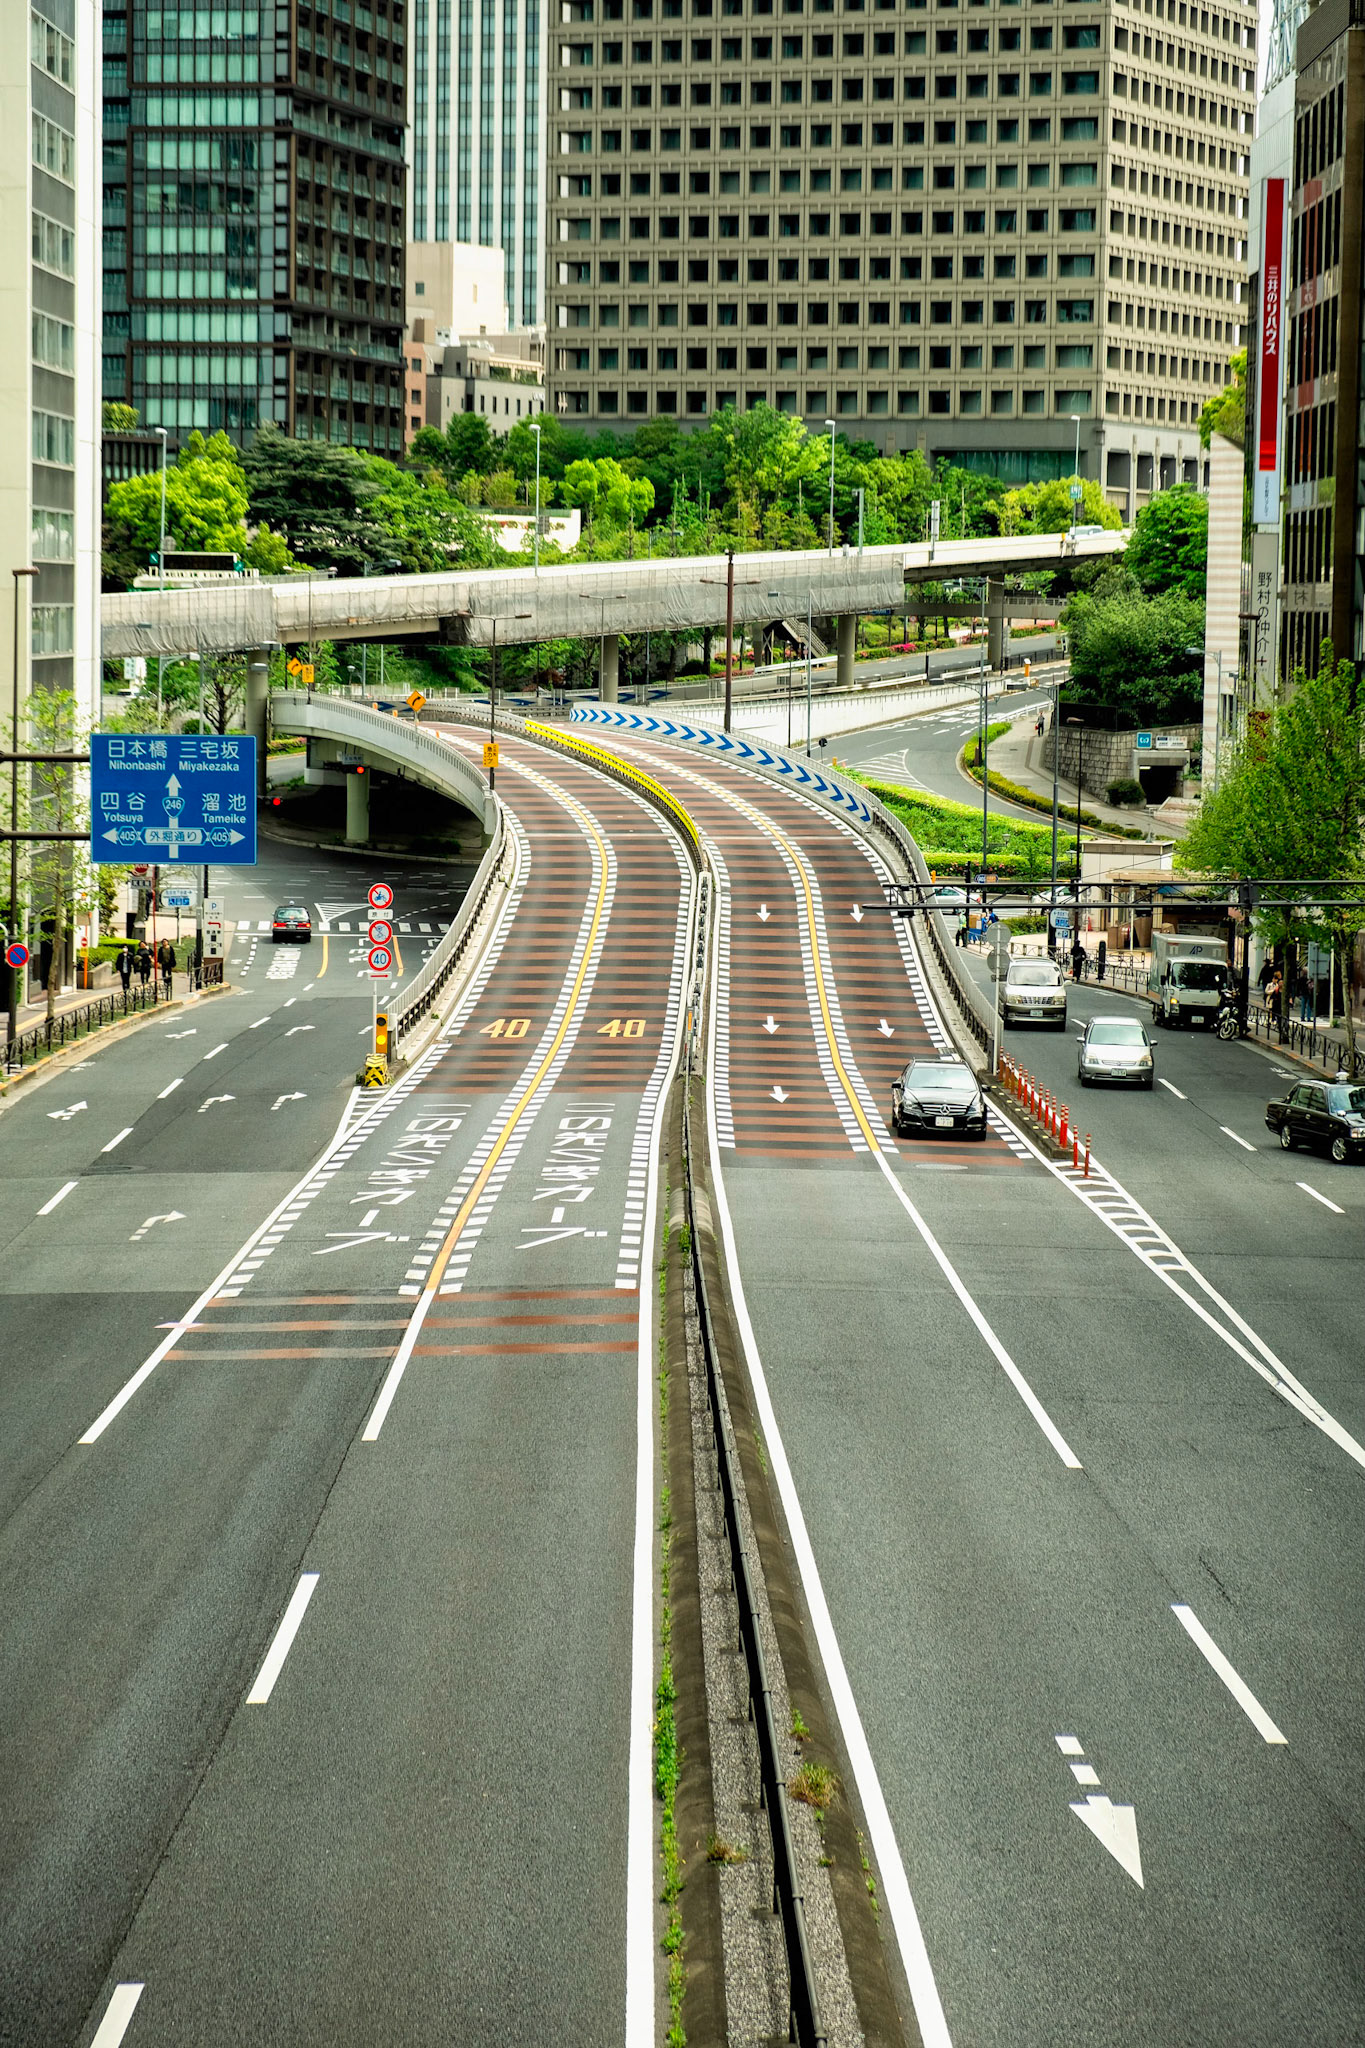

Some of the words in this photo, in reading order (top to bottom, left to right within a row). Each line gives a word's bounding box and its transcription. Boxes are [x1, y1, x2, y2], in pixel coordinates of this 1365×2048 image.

[1265, 266, 1278, 356] 三井のリハウス
[108, 739, 168, 759] 日本橋
[179, 741, 240, 760] 三宅坂
[109, 760, 166, 771] Nihonbashi
[178, 761, 240, 773] Miyakezaka
[165, 800, 182, 810] 246
[103, 812, 144, 824] Yotsuya
[202, 813, 247, 824] Tameike
[119, 832, 136, 841] 405
[149, 830, 197, 842] 外堀通り
[211, 832, 228, 842] 405
[373, 953, 387, 965] 40
[479, 1018, 531, 1038] 40
[597, 1019, 646, 1038] 40
